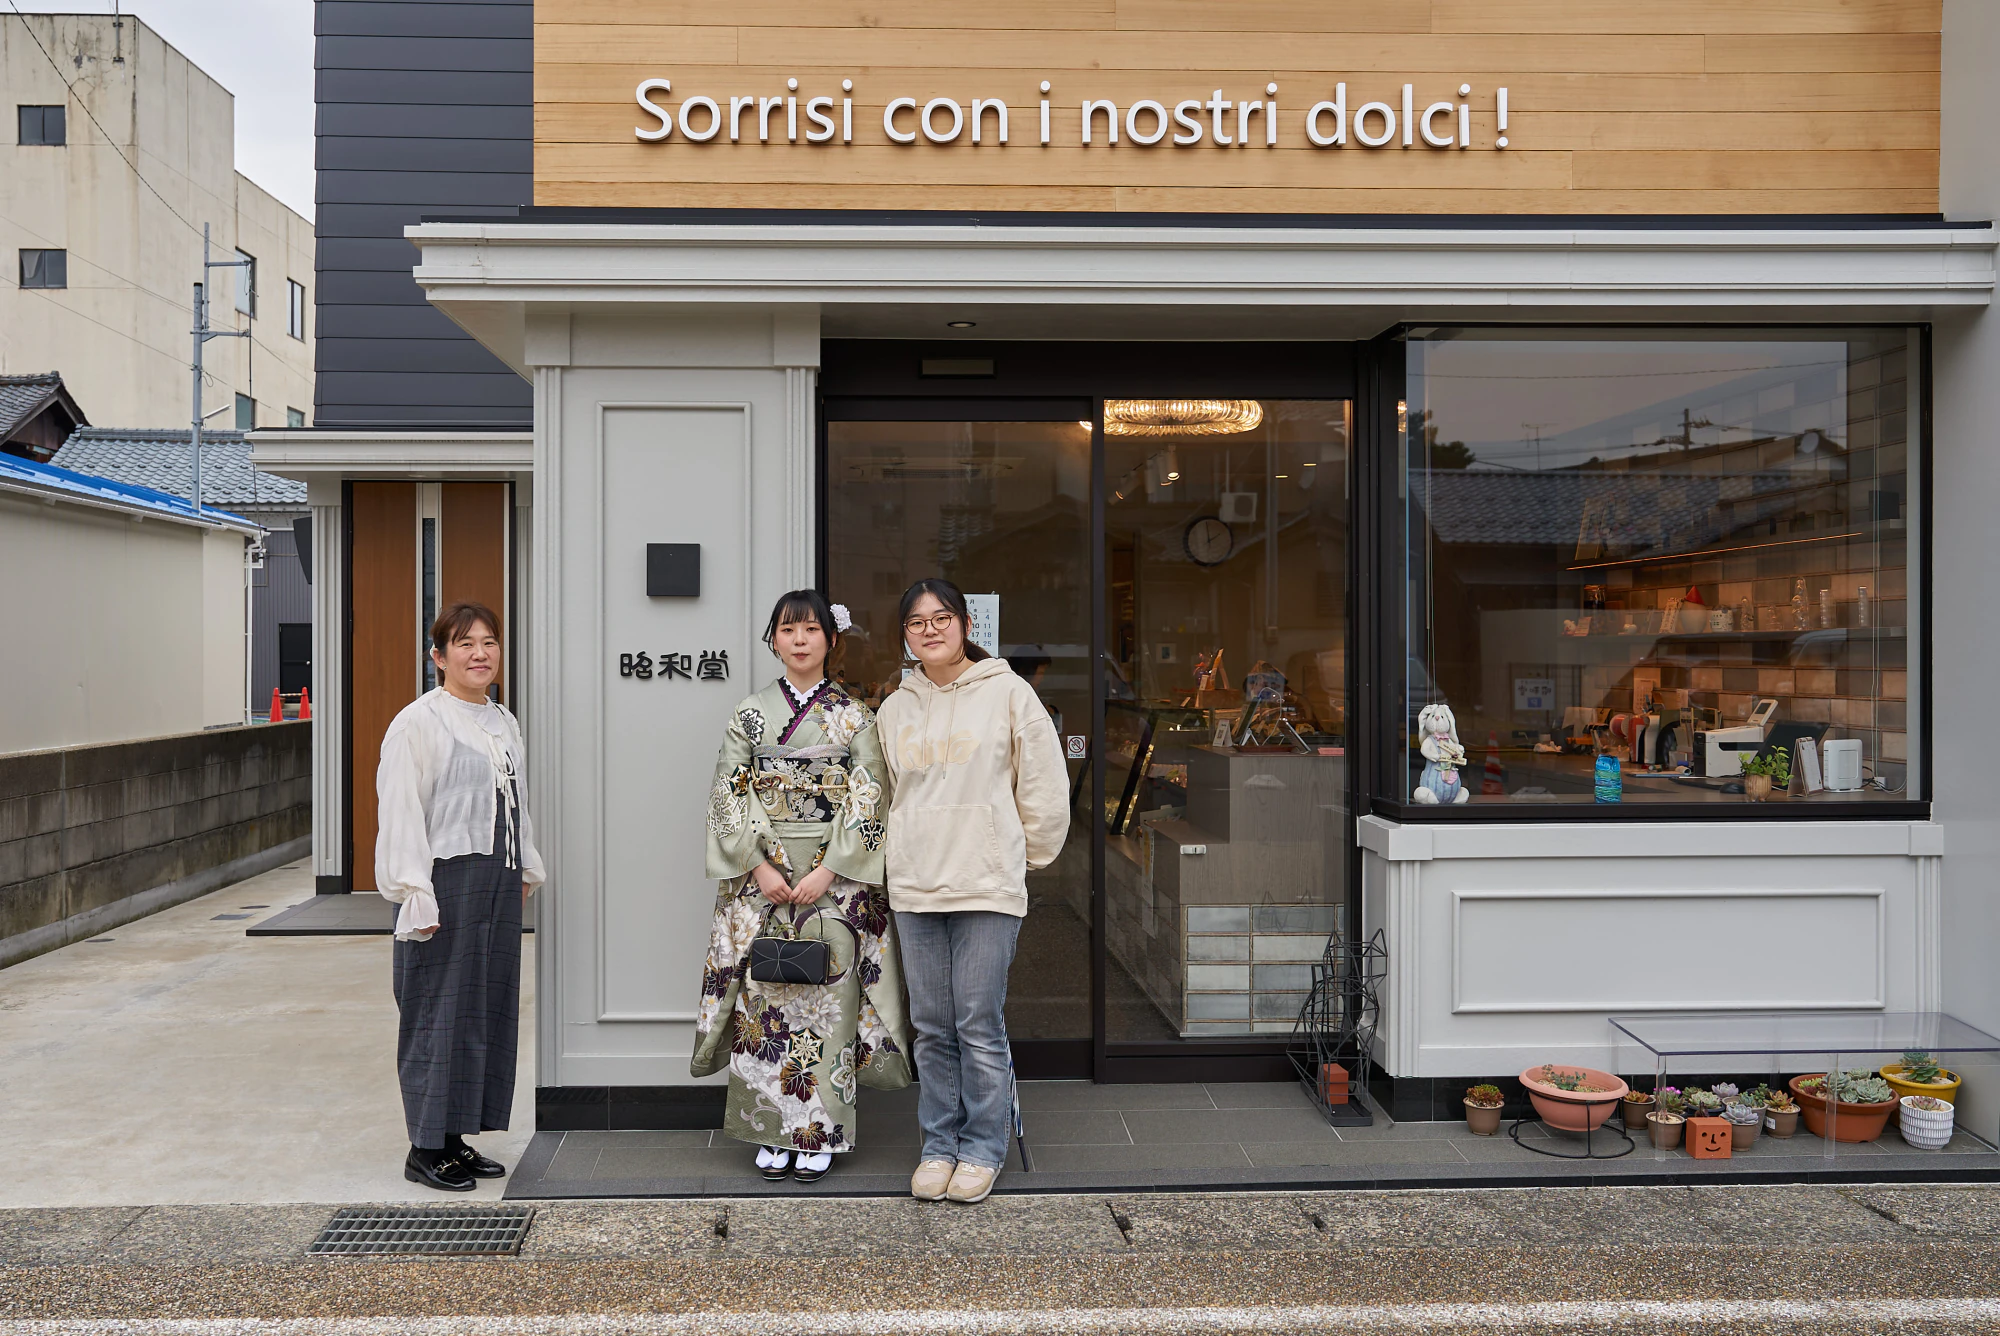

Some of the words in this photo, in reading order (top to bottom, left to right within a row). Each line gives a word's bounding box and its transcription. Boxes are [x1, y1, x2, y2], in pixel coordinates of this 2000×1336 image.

[635, 78, 852, 142] Sorrisi
[883, 97, 1009, 144] con
[1040, 80, 1051, 144] i
[1081, 82, 1278, 146] nostri
[1305, 82, 1471, 148] dolci
[1495, 87, 1509, 150] !
[620, 649, 729, 680] 昭和堂
